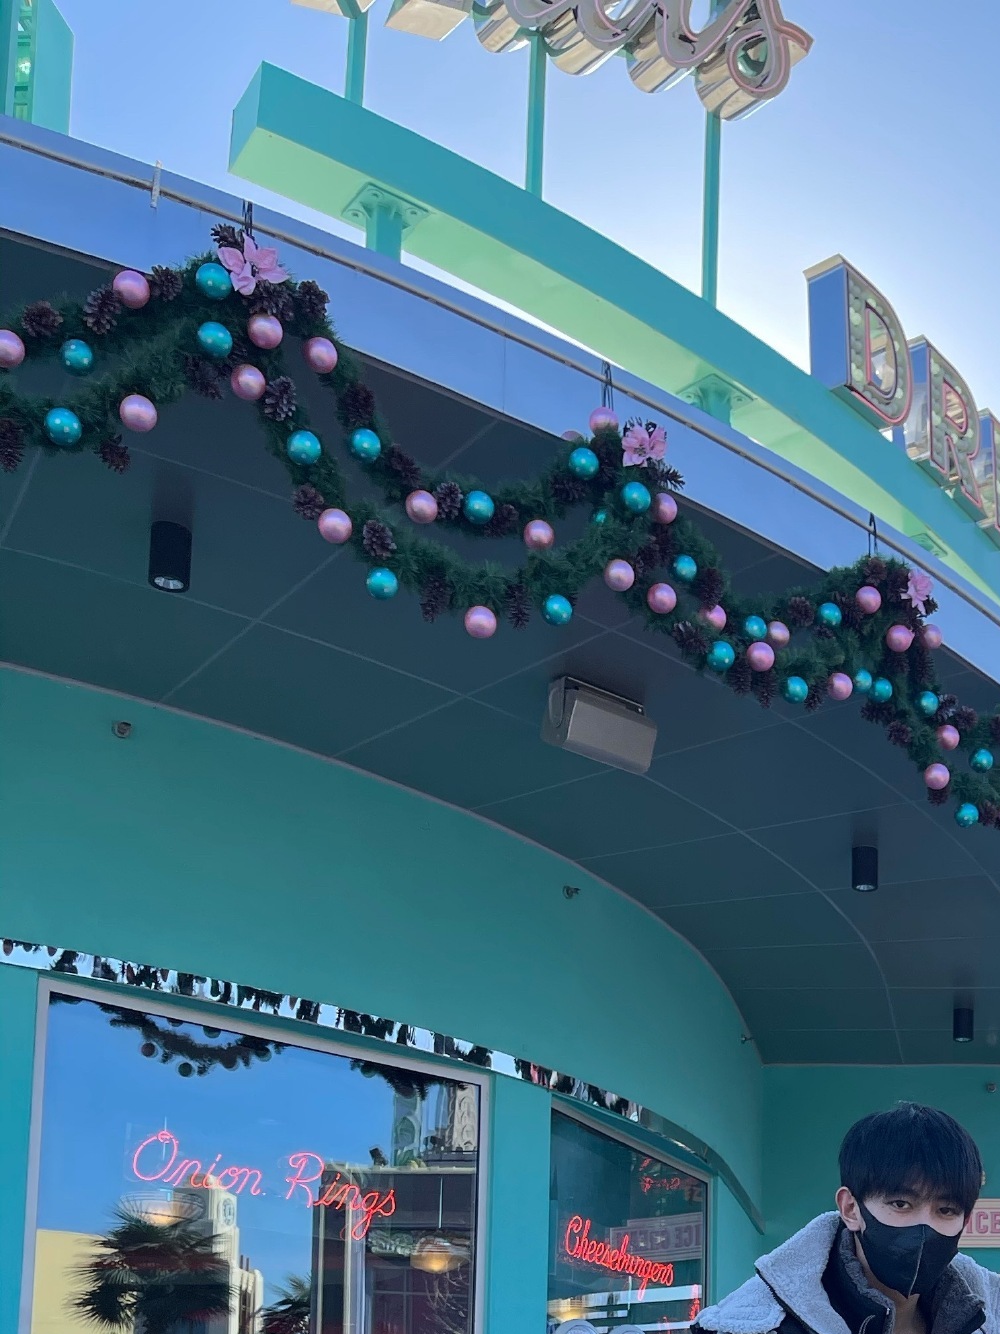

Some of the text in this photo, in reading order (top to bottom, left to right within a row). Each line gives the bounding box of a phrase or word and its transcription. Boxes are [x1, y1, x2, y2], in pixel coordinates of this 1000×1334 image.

[133, 1130, 396, 1240] Onion Rings
[565, 1216, 674, 1301] Cheeseburgers
